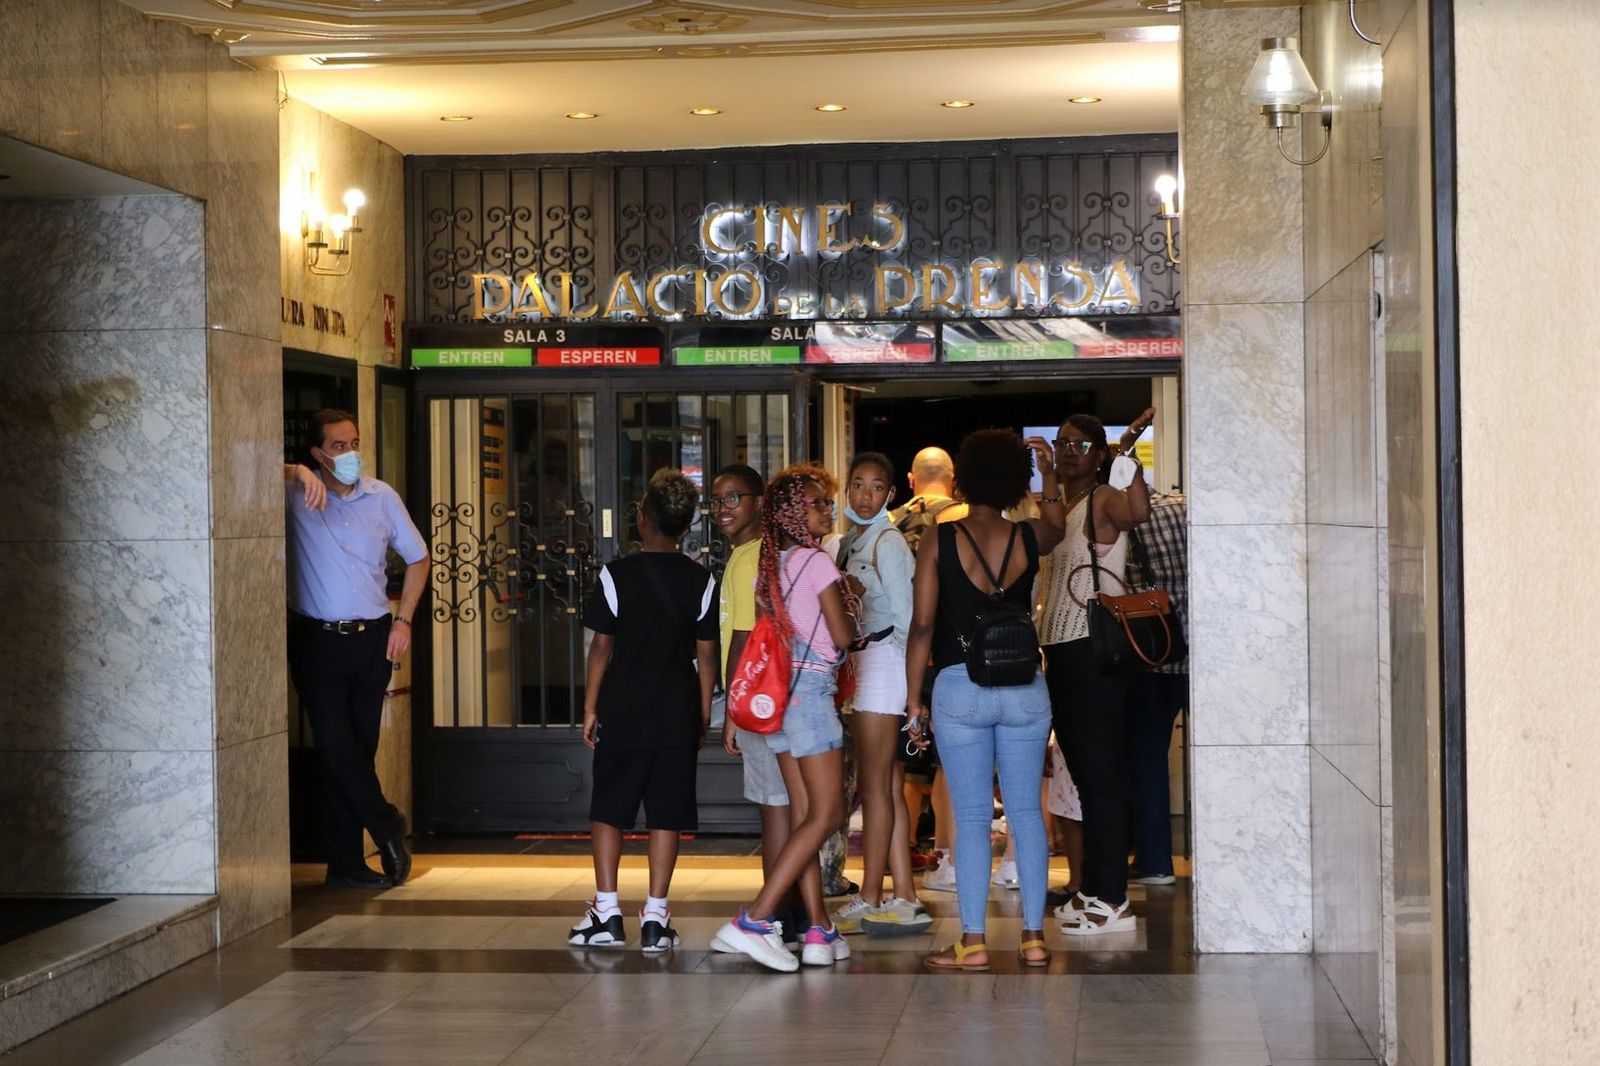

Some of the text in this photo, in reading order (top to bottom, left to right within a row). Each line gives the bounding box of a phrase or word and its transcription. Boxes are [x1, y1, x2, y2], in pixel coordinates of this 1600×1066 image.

[703, 202, 903, 254] CINES
[471, 260, 1143, 320] PALACIO DE LA PRENSA
[503, 329, 567, 343] SALA 3
[770, 327, 815, 341] SALA
[704, 348, 772, 362] ENTREN
[976, 344, 1046, 357] ENTREN
[1104, 341, 1184, 356] ESPEREN
[438, 351, 505, 364] ENTREN
[560, 350, 637, 364] ESPEREN
